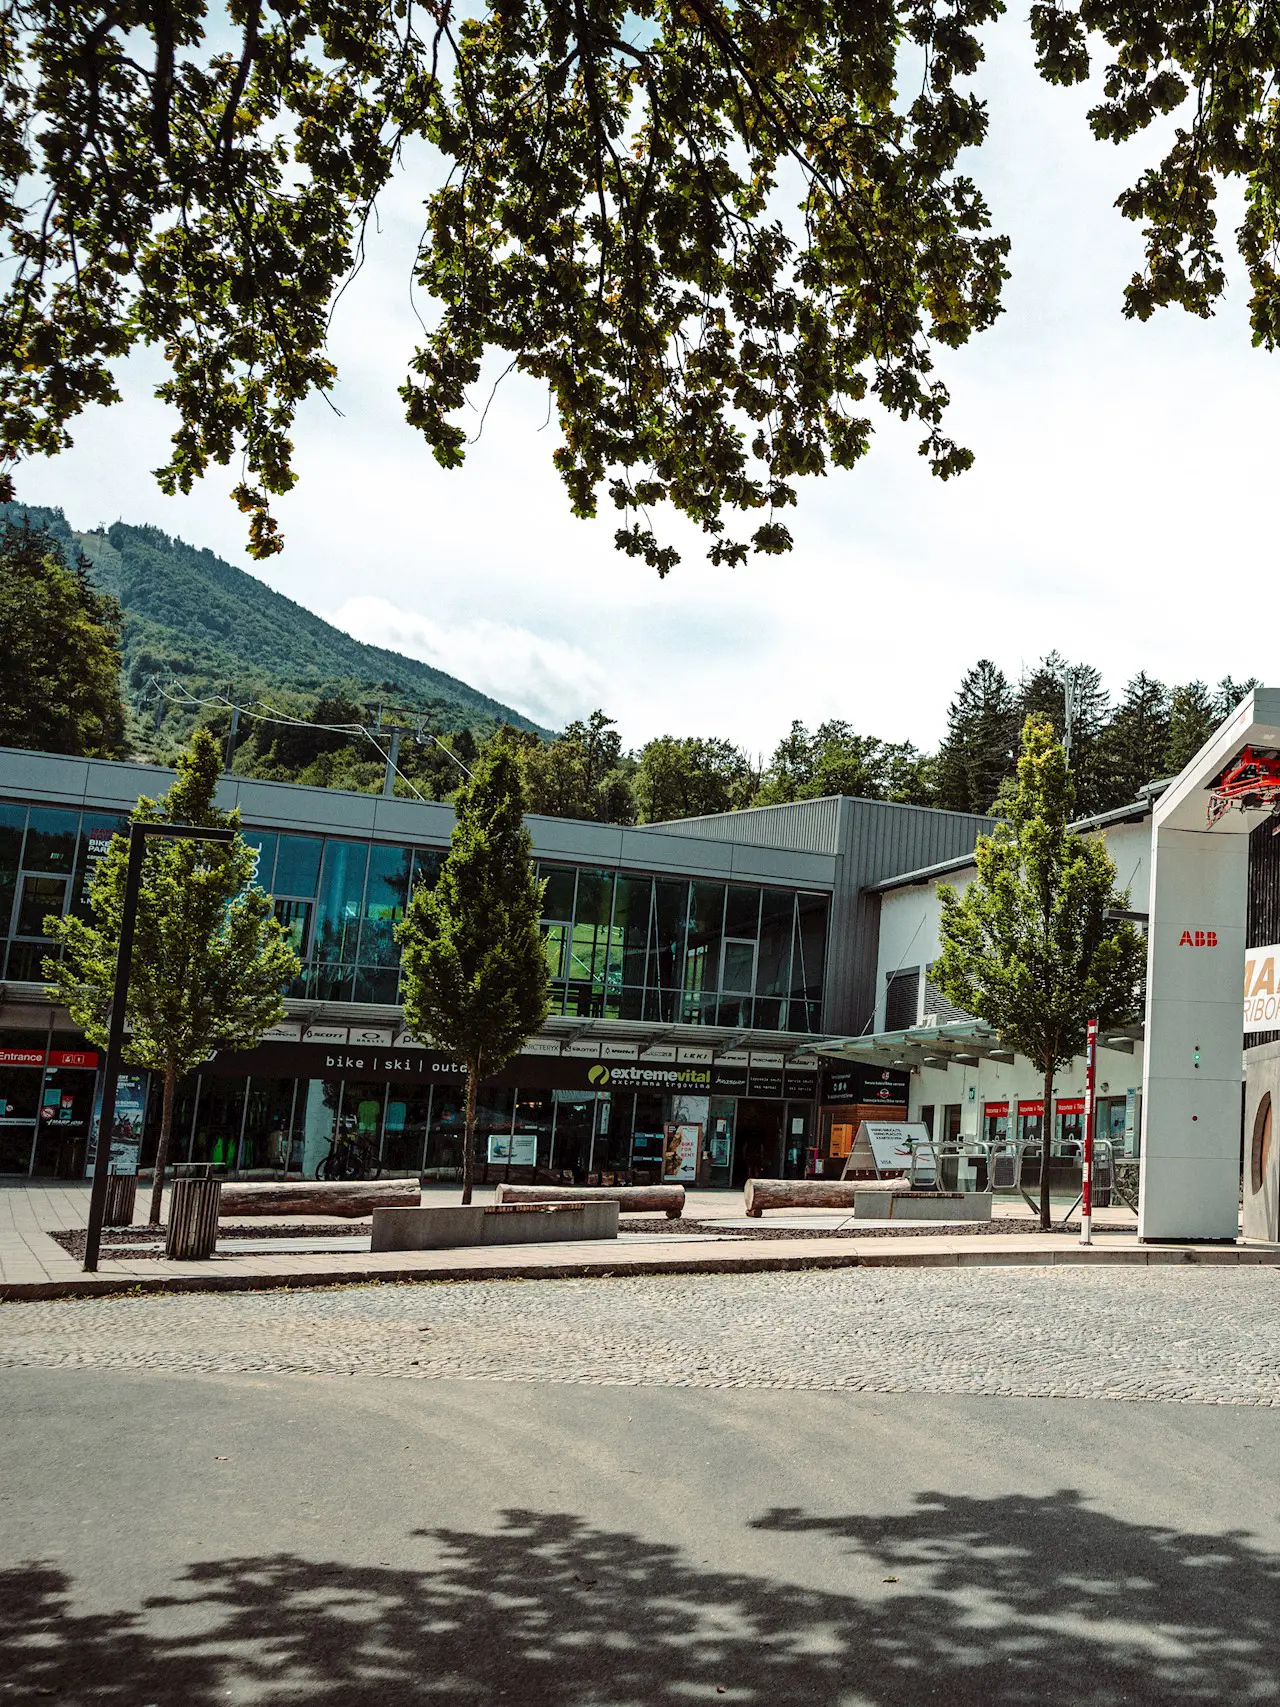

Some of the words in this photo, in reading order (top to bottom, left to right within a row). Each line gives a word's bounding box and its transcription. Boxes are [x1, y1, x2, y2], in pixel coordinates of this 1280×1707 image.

[1178, 931, 1218, 947] ABB
[0, 1052, 42, 1062] Entrance
[683, 1052, 708, 1060] LEKI
[326, 1056, 364, 1068] bike
[384, 1059, 412, 1071] ski
[611, 1066, 711, 1084] extremevital
[611, 1079, 661, 1088] extremna
[665, 1081, 711, 1090] trgovina
